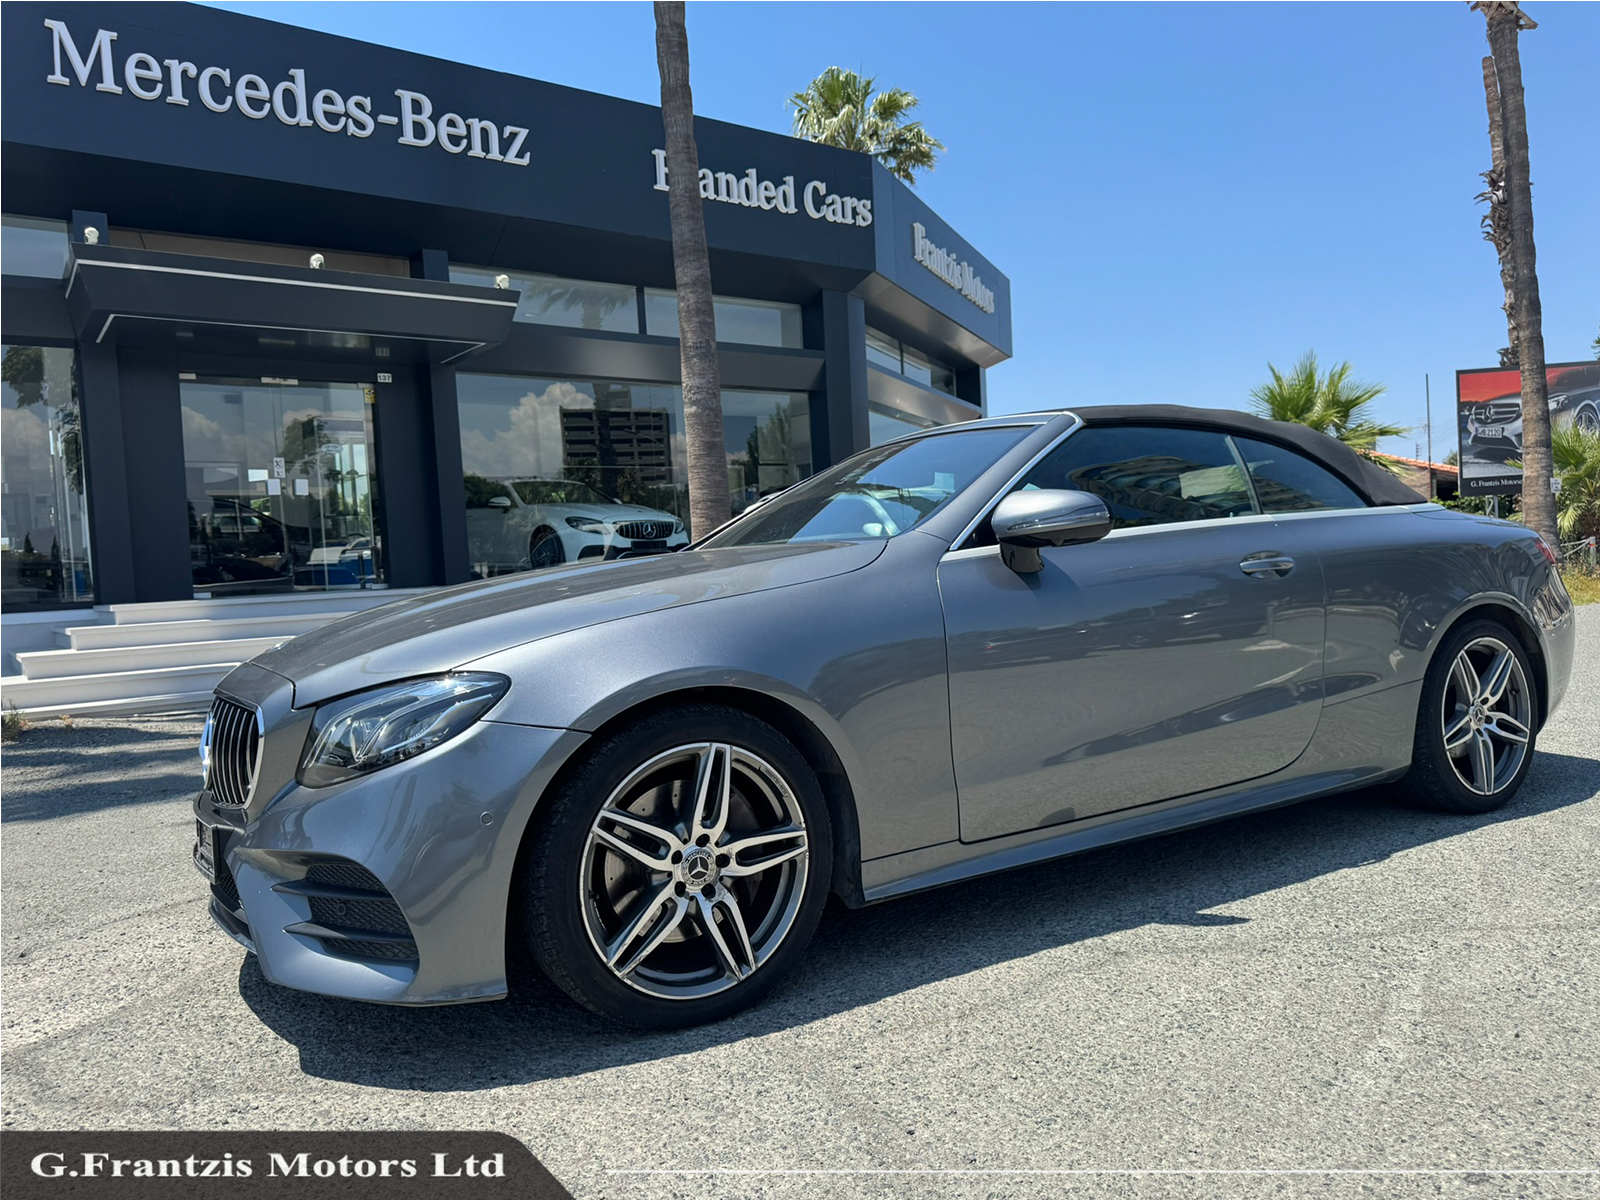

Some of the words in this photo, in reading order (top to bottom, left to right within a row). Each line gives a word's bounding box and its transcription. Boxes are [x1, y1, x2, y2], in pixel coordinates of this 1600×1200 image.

[44, 18, 531, 166] Mercedes-Benz
[803, 180, 873, 227] Cars
[913, 222, 962, 289] Frantzis
[961, 261, 995, 314] Motors
[378, 374, 391, 382] 137
